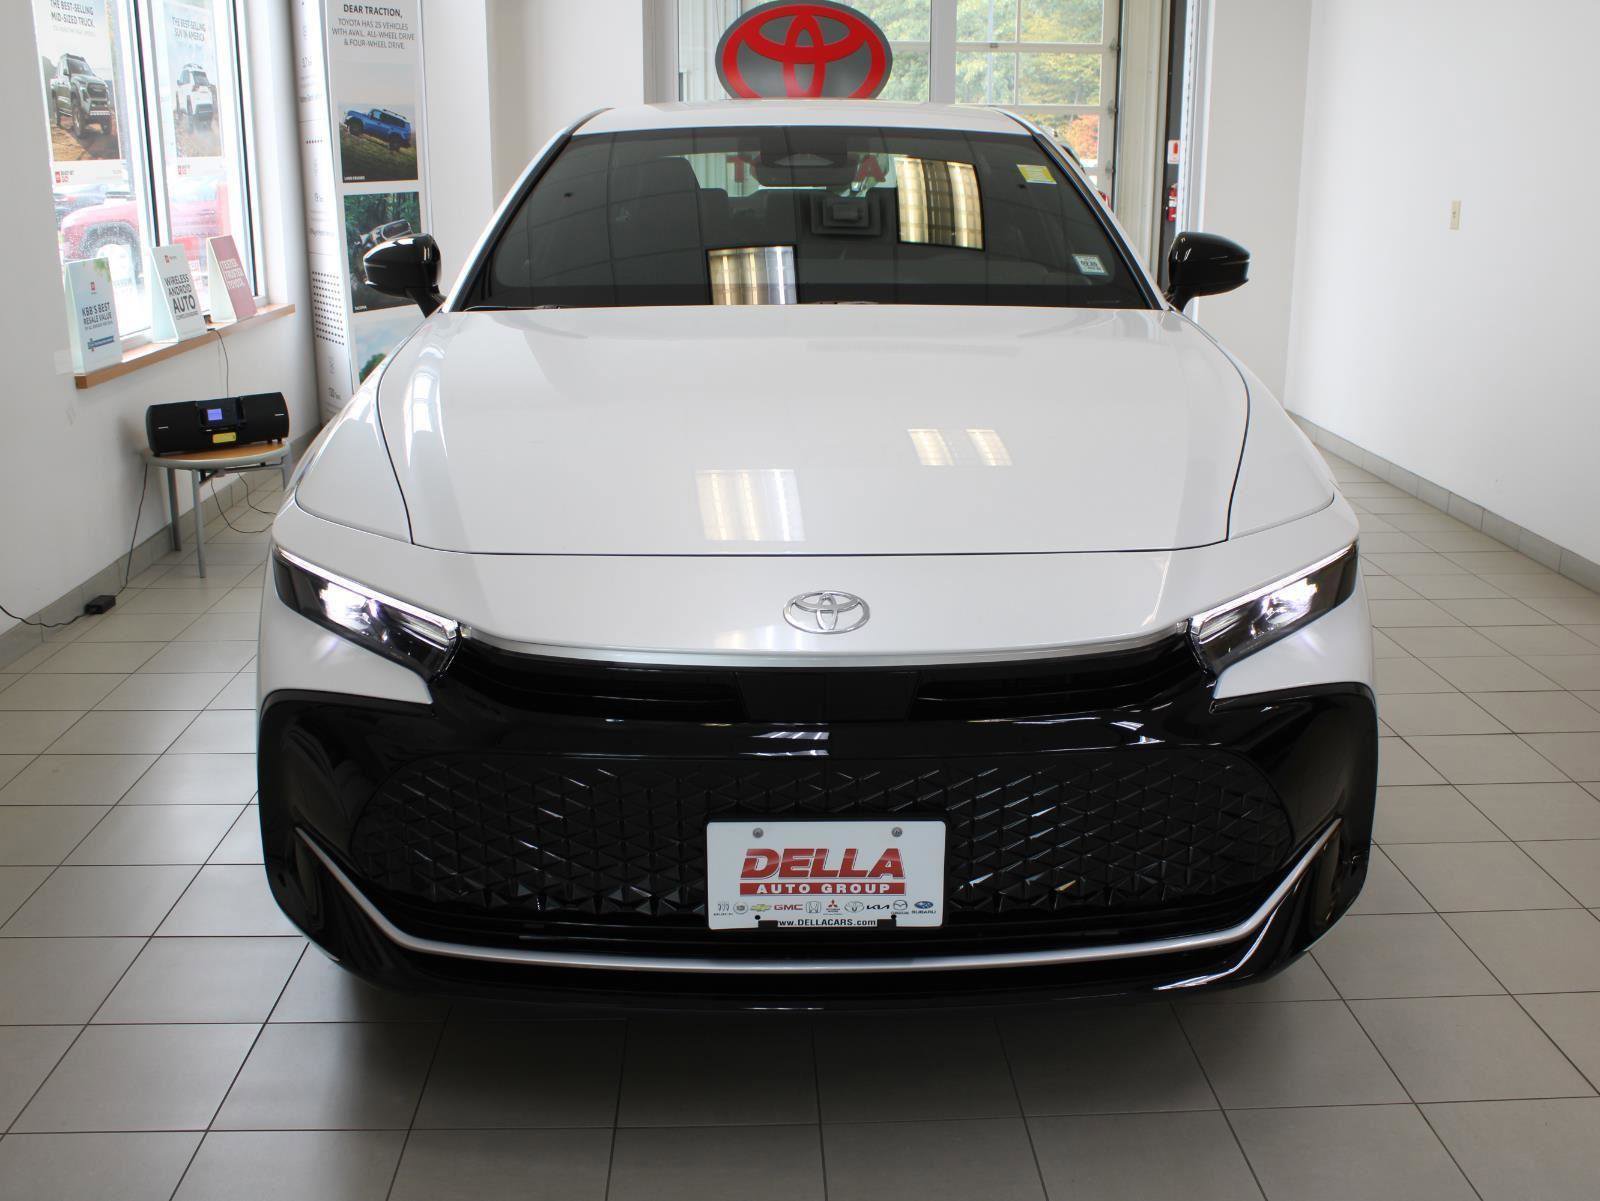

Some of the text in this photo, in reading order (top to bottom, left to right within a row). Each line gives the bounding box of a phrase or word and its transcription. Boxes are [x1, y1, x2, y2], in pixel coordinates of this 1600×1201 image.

[51, 11, 77, 24] MID-SIZED
[343, 4, 403, 19] DEAR TRACTION,
[338, 18, 361, 27] TOYOTA
[361, 19, 374, 28] HAS
[383, 22, 409, 31] VEHICLES
[332, 27, 347, 36] WITH
[398, 32, 416, 41] DRIVE
[164, 273, 189, 287] WIRELESS
[168, 284, 192, 297] ANDROID
[98, 302, 111, 314] BEST
[172, 295, 196, 314] AUTO
[83, 314, 99, 325] RESALE
[99, 311, 112, 322] VALUE
[740, 847, 906, 880] DELLA
[756, 883, 891, 895] AUTO GROUP
[774, 903, 804, 911] GMC
[778, 918, 877, 926] ww.DELLACARS.com
